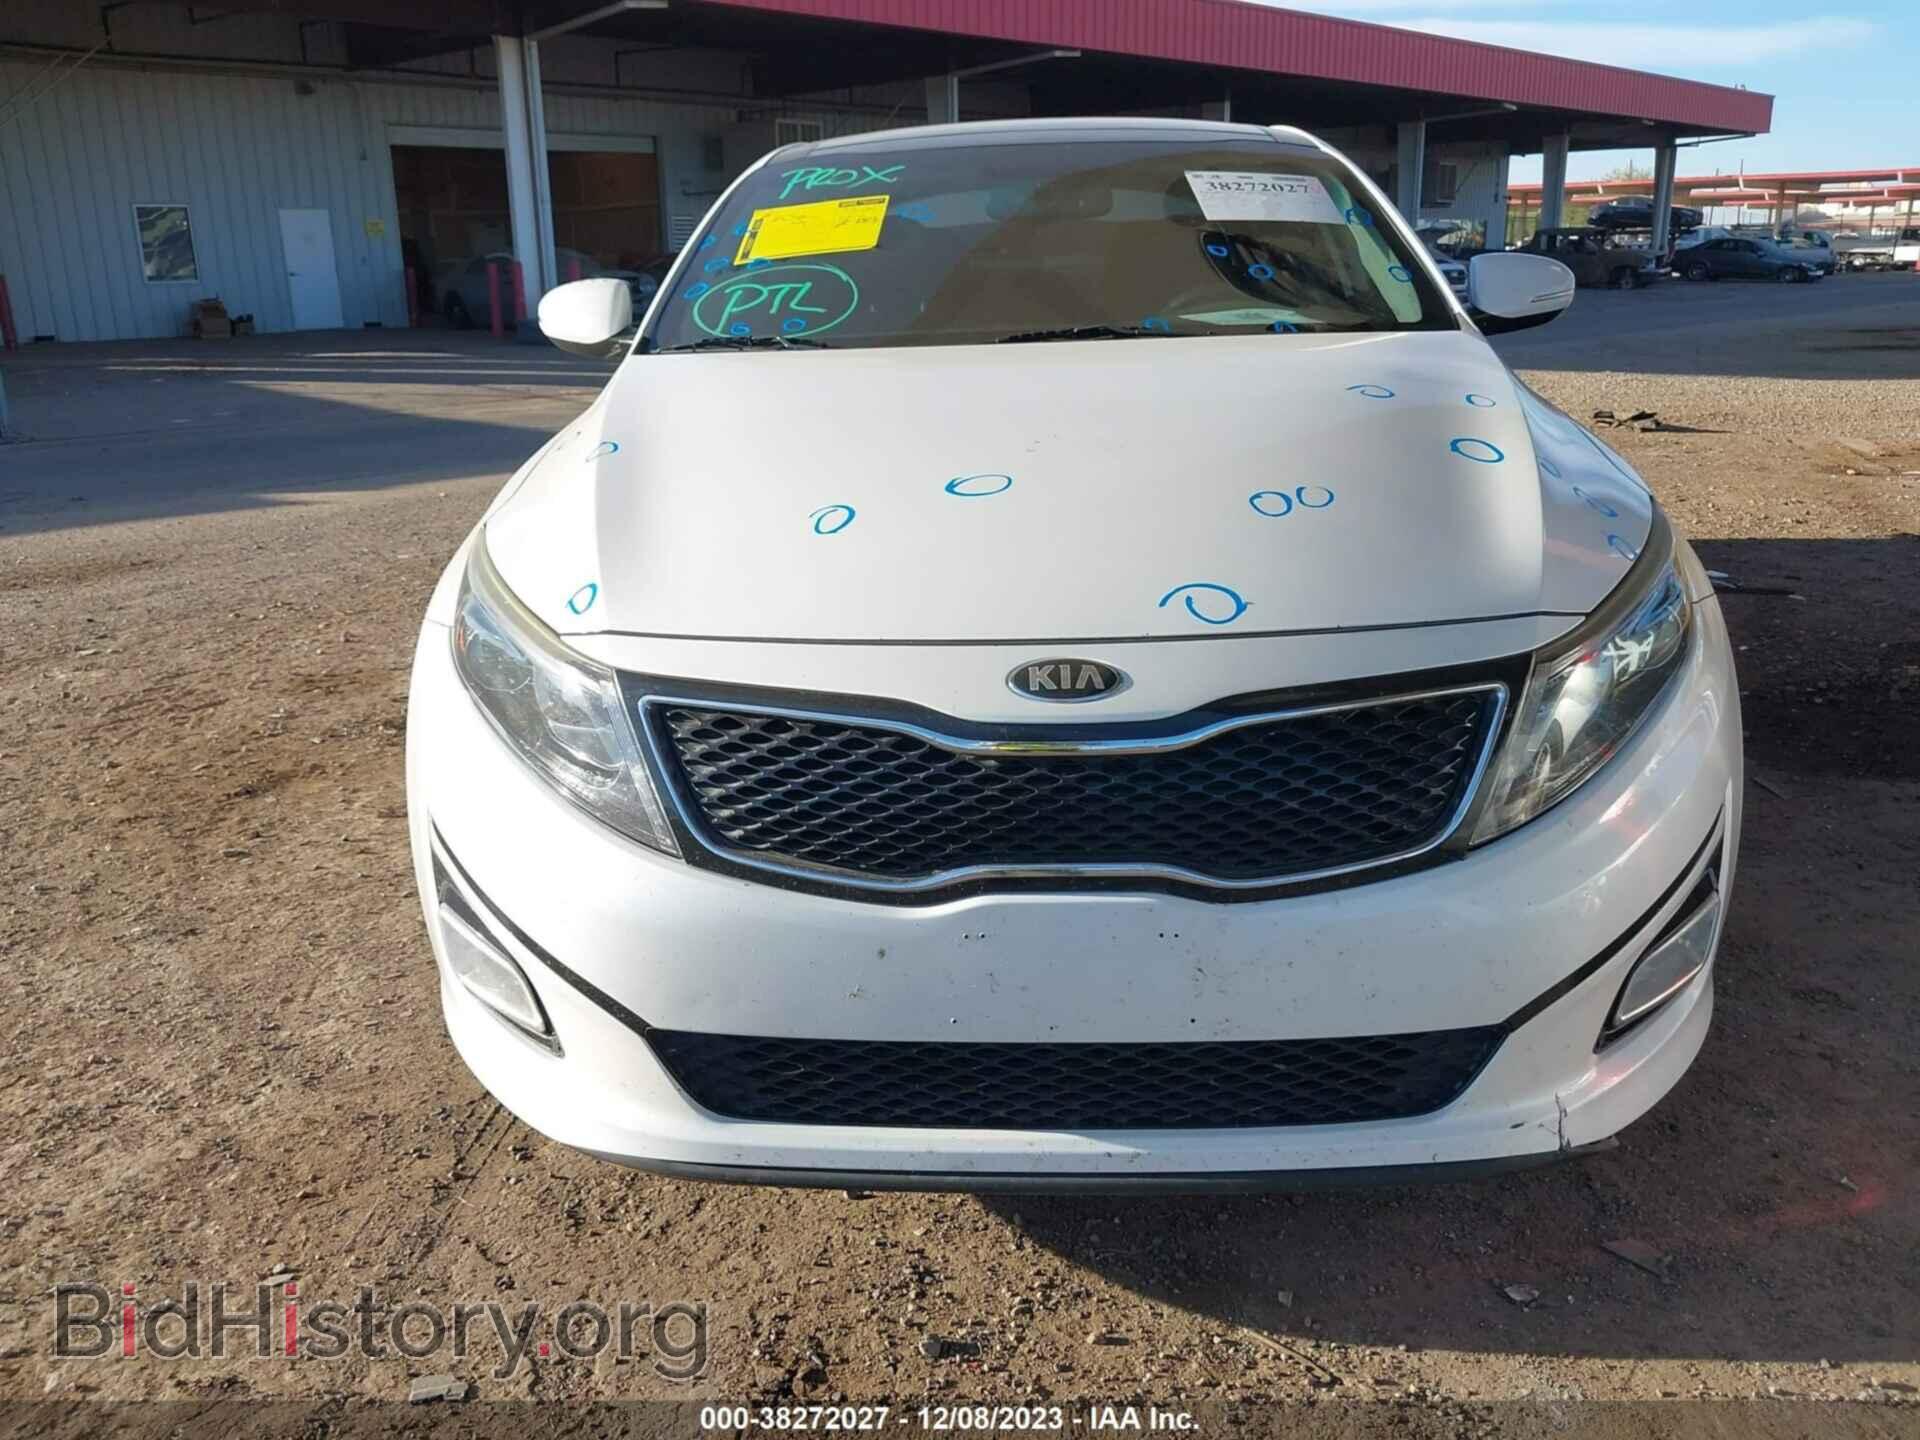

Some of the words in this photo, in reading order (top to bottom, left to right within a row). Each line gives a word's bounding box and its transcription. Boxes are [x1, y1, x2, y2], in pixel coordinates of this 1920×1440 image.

[1205, 181, 1309, 193] 38272027
[714, 281, 828, 336] PTL
[1028, 663, 1106, 691] KIA
